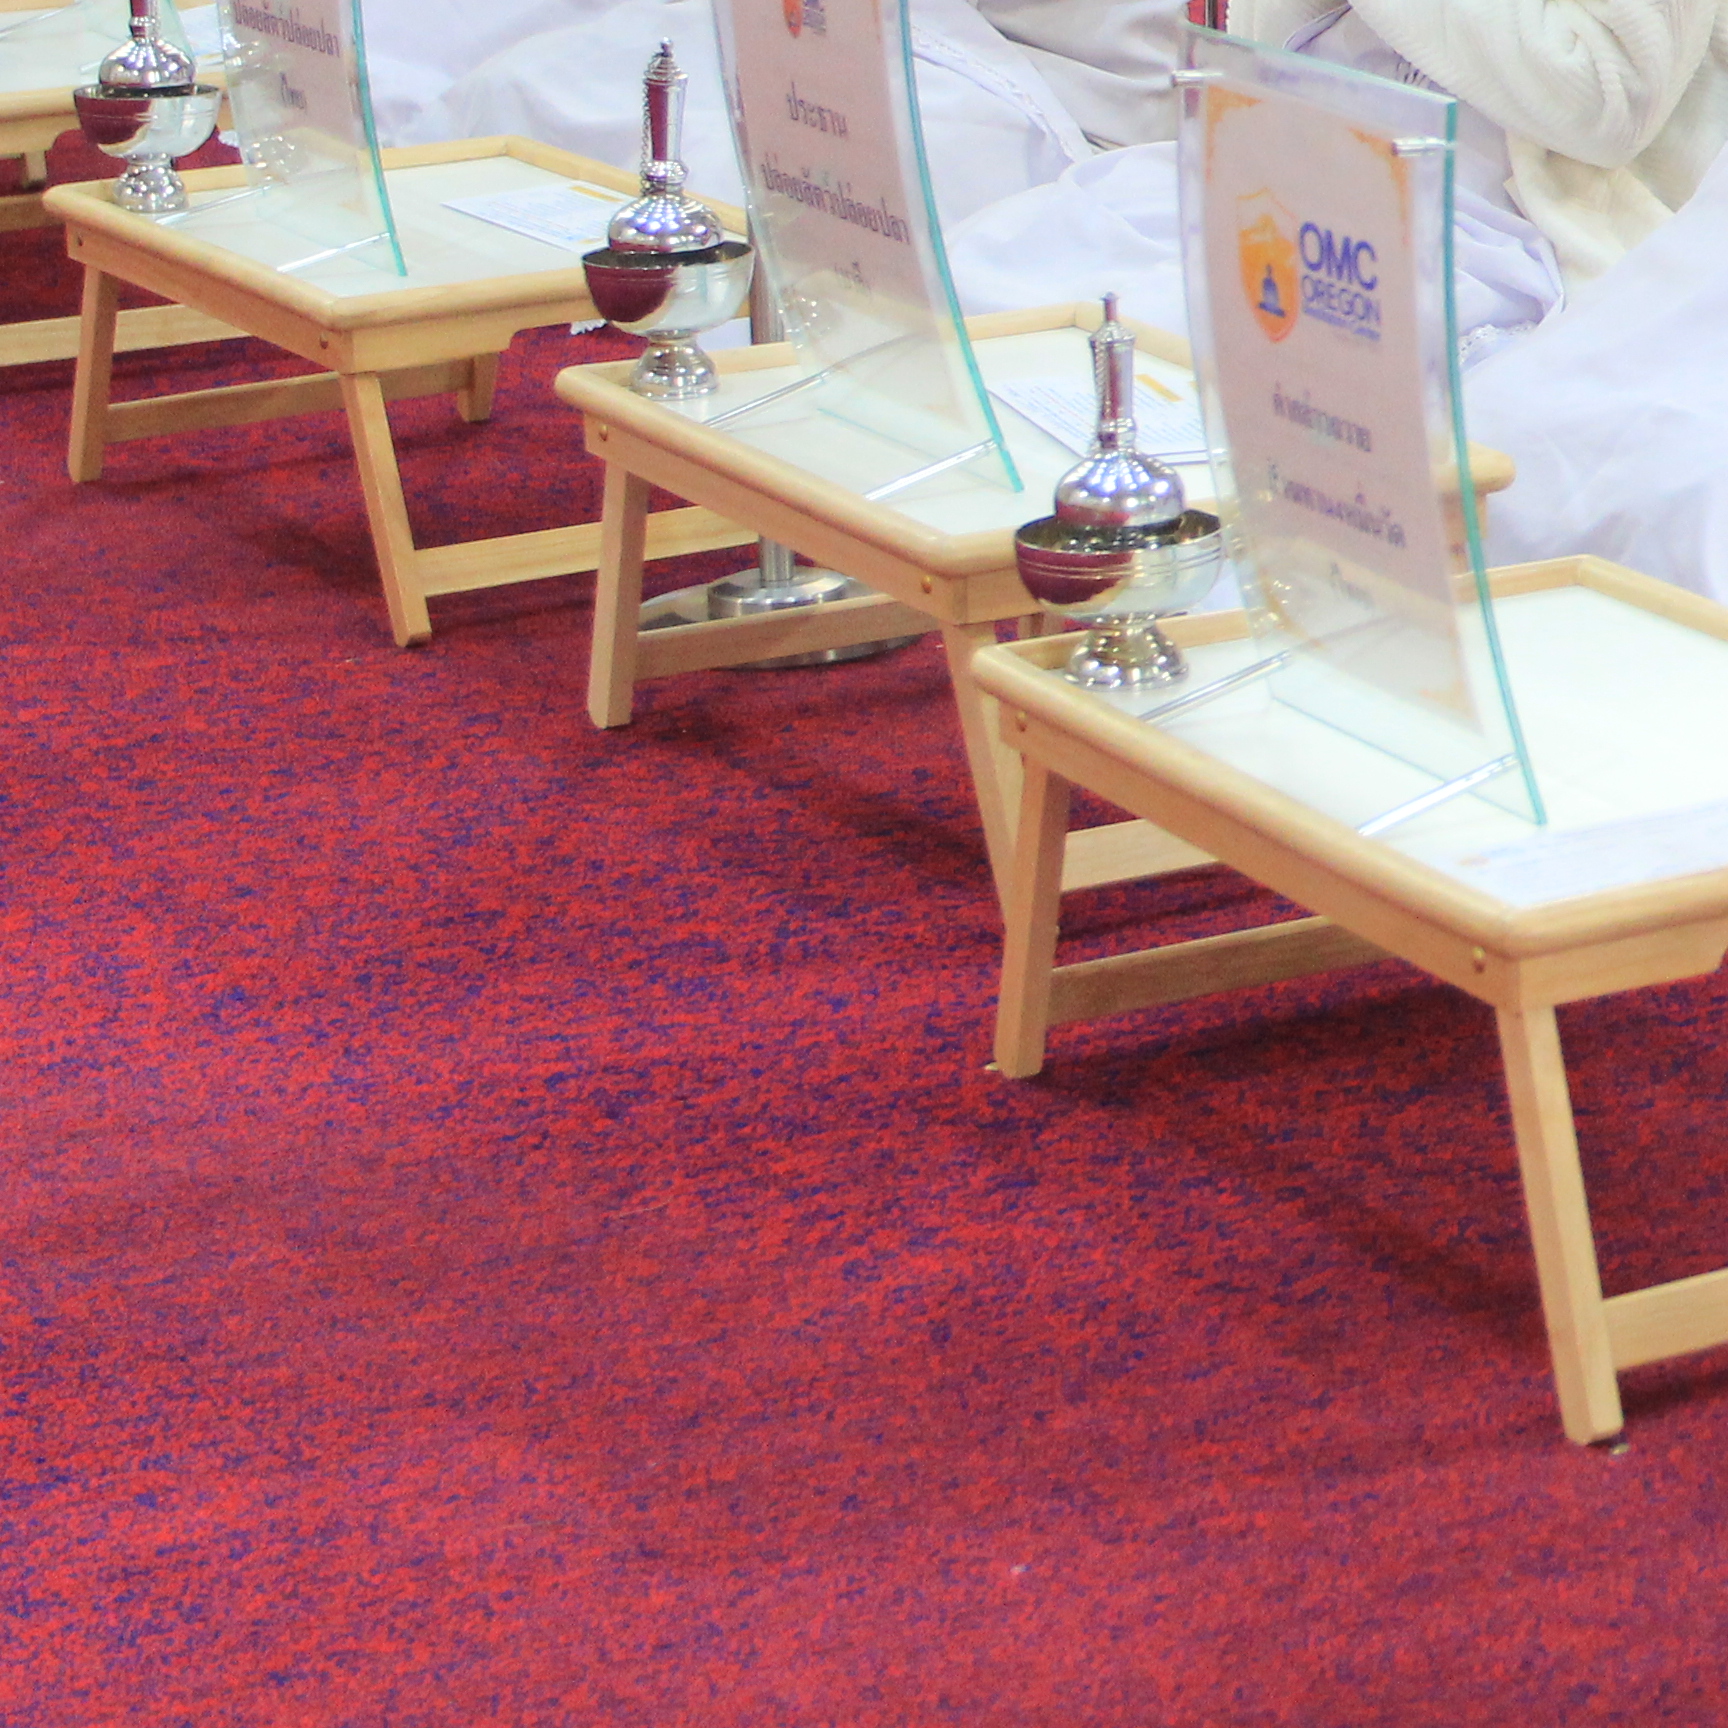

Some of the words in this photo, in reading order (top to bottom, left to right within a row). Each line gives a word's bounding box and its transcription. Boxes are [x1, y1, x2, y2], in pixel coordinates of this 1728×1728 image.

[786, 80, 849, 138] ประธาน
[761, 151, 911, 246] ปล่อยสัตว์ปล่อยปลา
[1299, 220, 1379, 291] OMC
[1301, 274, 1382, 326] OREGON
